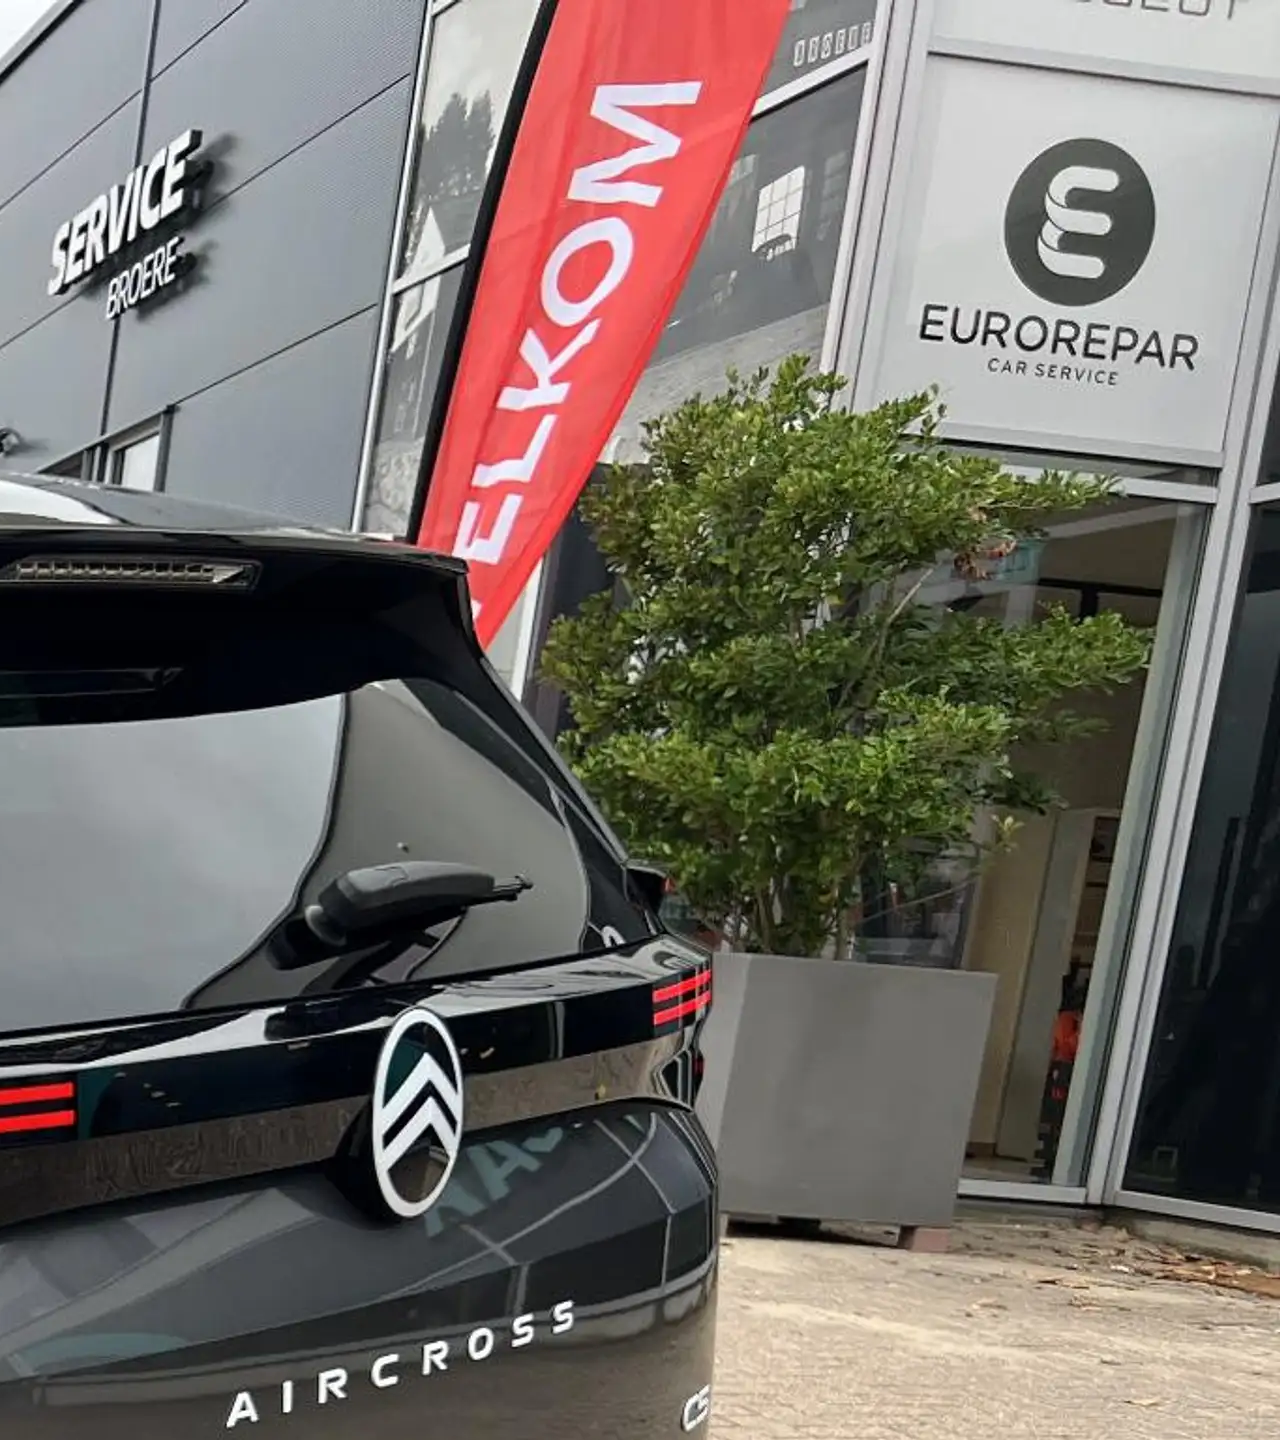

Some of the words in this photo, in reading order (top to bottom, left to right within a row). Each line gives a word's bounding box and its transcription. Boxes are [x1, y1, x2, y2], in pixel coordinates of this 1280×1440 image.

[47, 129, 204, 296] SERVICE
[104, 237, 185, 320] BROERE
[918, 303, 1200, 372] EUROREPAR
[986, 357, 1027, 376] CAR
[1034, 361, 1120, 387] SERVICE
[226, 1300, 575, 1428] AIRCROSS
